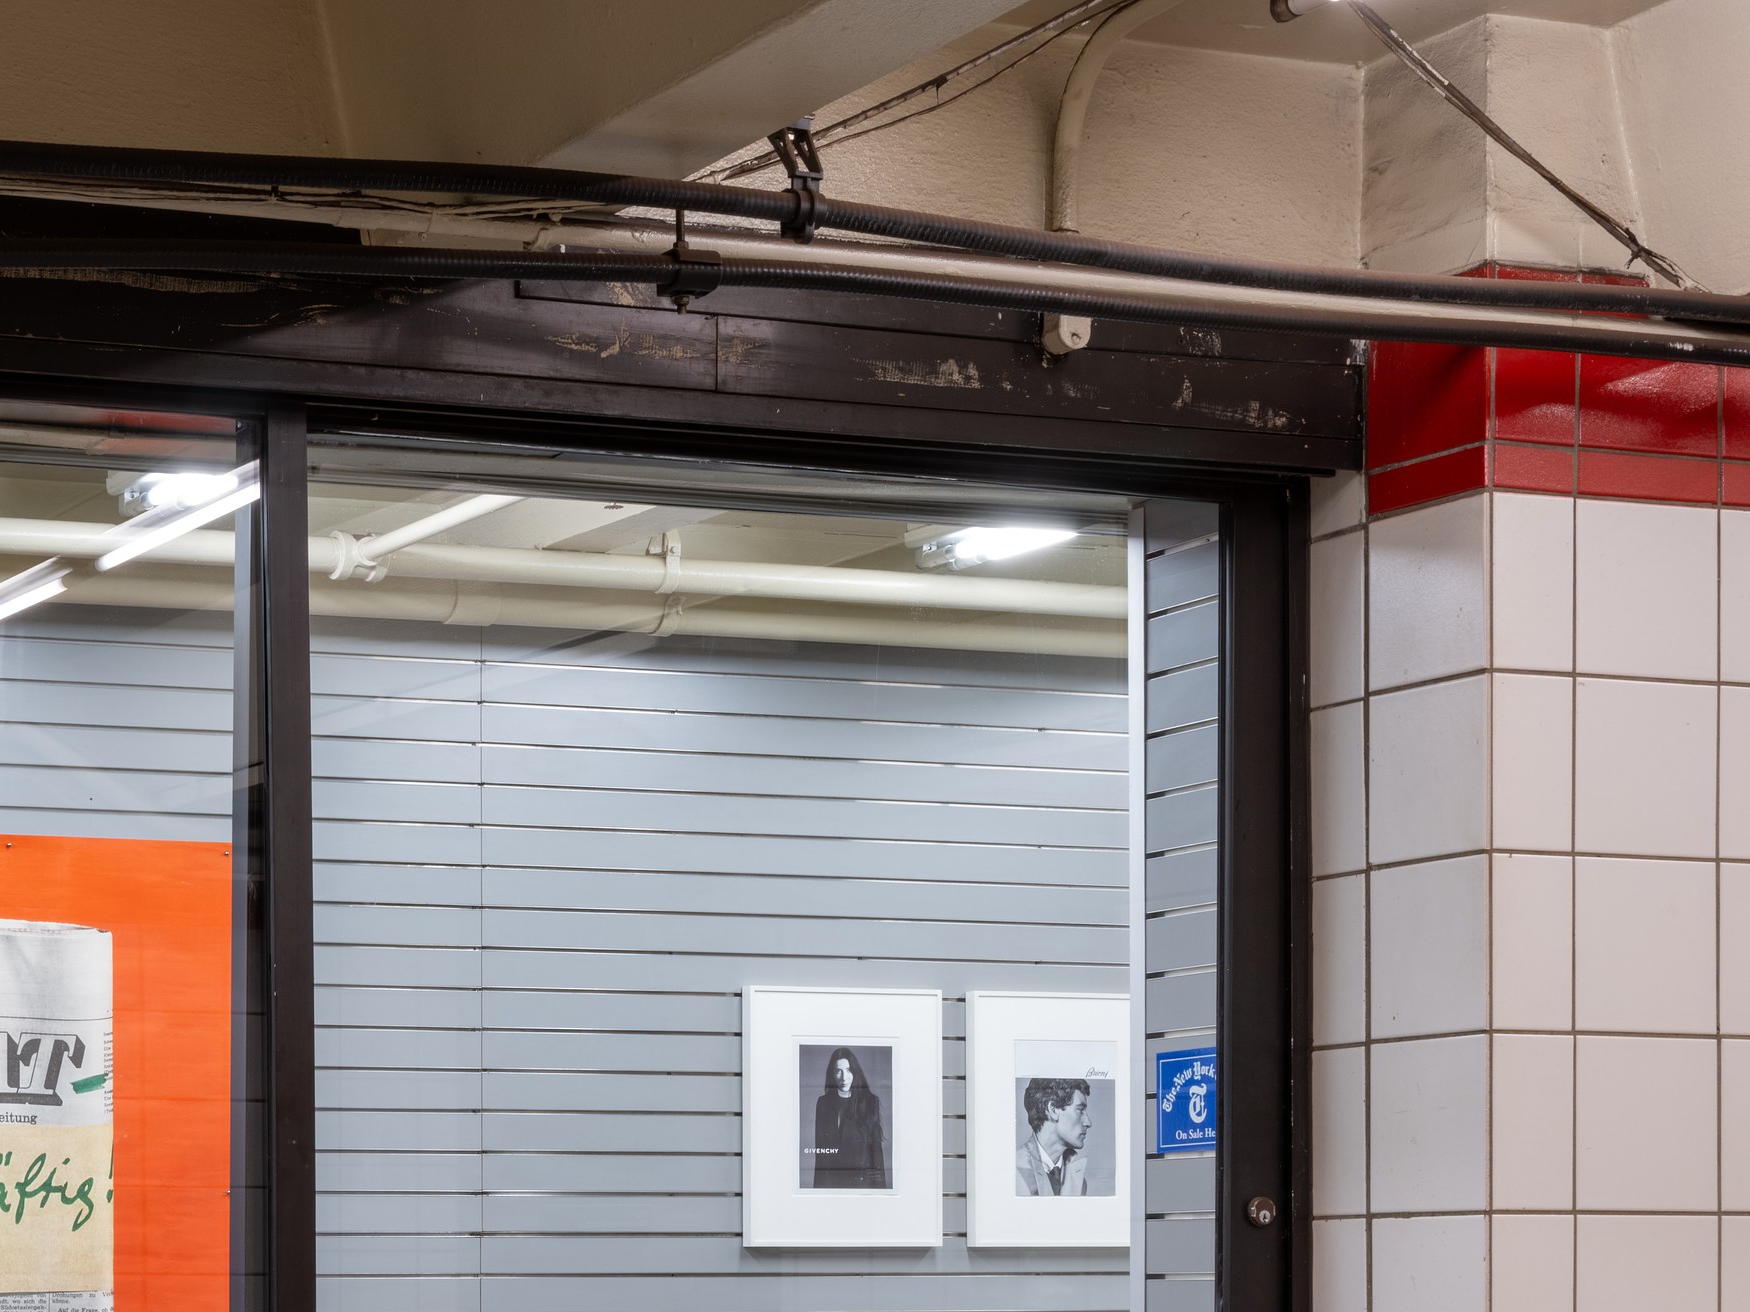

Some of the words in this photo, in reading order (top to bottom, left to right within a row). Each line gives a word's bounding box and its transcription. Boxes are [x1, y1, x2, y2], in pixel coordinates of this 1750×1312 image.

[1162, 1087, 1176, 1112] The
[1173, 1068, 1192, 1091] New
[1193, 1062, 1216, 1080] York
[1176, 1130, 1187, 1140] On
[1188, 1128, 1204, 1138] Sale
[1205, 1128, 1216, 1138] He
